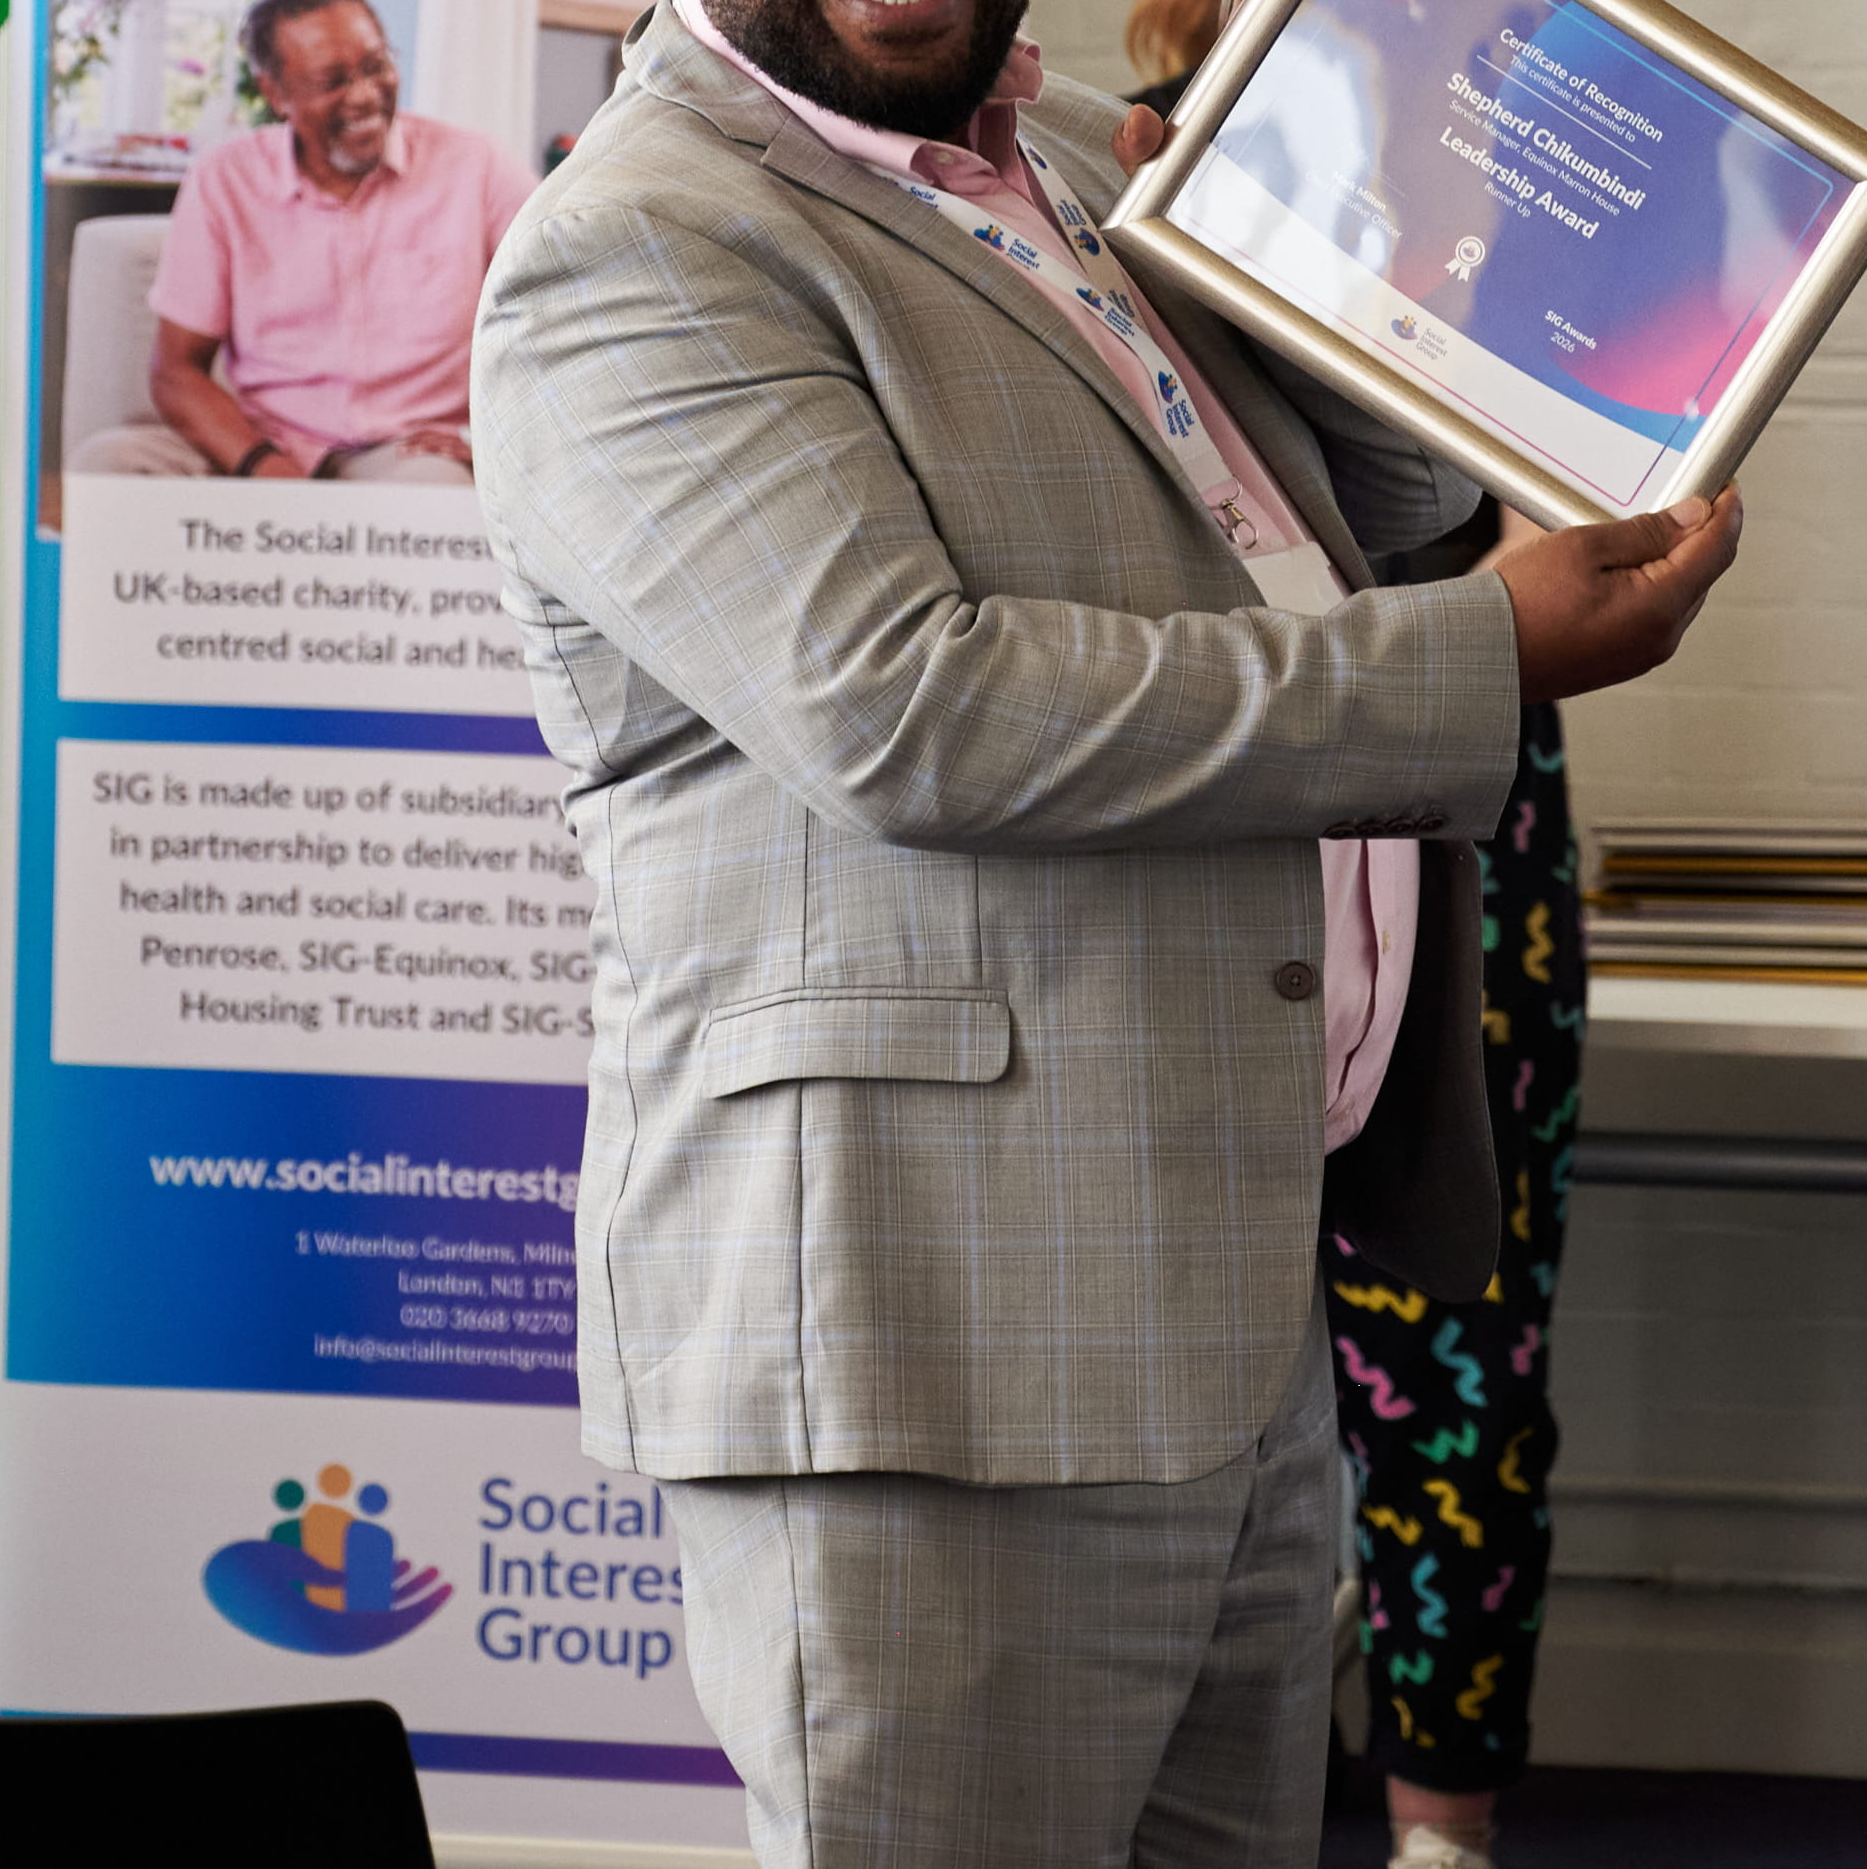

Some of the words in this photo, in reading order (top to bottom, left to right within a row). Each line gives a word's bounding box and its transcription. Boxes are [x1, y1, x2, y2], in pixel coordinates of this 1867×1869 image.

[1500, 29, 1568, 81] Certificate
[1569, 74, 1587, 91] of
[1585, 83, 1663, 143] Recognition
[1510, 55, 1528, 75] This
[1528, 66, 1578, 102] certificate
[1572, 93, 1580, 107] is
[1580, 100, 1631, 137] presented
[1625, 129, 1636, 143] to
[1447, 72, 1535, 138] Shepherd
[1533, 128, 1646, 211] Chikumbindi
[1449, 99, 1482, 127] Service
[1482, 120, 1521, 154] Manager,
[1522, 146, 1557, 176] Equinox
[1558, 169, 1591, 198] Marron
[1591, 190, 1620, 217] House
[1357, 185, 1386, 212] Milton
[1439, 126, 1535, 200] Leadership
[1535, 190, 1600, 240] Award
[1485, 181, 1517, 210] Runner
[1517, 202, 1531, 218] Up
[1008, 246, 1040, 269] Interest
[1012, 238, 1038, 259] Social
[1424, 328, 1447, 346] Social
[1545, 310, 1564, 327] SIG
[1561, 322, 1597, 350] Awards
[1550, 332, 1575, 353] 2026
[1166, 408, 1177, 436] Group
[1172, 403, 1189, 438] Interest
[1179, 399, 1194, 427] Social
[181, 519, 243, 552] The
[254, 523, 355, 556] Social
[113, 573, 284, 609] UK-based
[293, 578, 420, 616] charity,
[157, 630, 289, 663] centred
[299, 633, 395, 666] social
[405, 637, 466, 669] and
[93, 772, 152, 806] SIG
[163, 773, 188, 806] is
[199, 777, 293, 811] made
[303, 785, 345, 817] up
[356, 783, 392, 813] of
[110, 828, 140, 859] in
[151, 833, 348, 870] partnership
[359, 840, 391, 867] to
[403, 839, 518, 873] deliver
[119, 881, 224, 915] health
[237, 885, 297, 918] and
[308, 887, 404, 921] social
[414, 896, 493, 924] care.
[505, 896, 547, 927] Its
[140, 935, 288, 972] Penrose,
[298, 941, 519, 983] SIG-Equinox,
[179, 992, 320, 1031] Housing
[330, 997, 420, 1030] Trust
[429, 1000, 492, 1034] and
[314, 1232, 420, 1260] Waterloo
[421, 1236, 517, 1266] Gardens,
[397, 1270, 483, 1297] London,
[399, 1303, 448, 1330] 020
[478, 1474, 665, 1540] Social
[476, 1607, 673, 1680] Group
